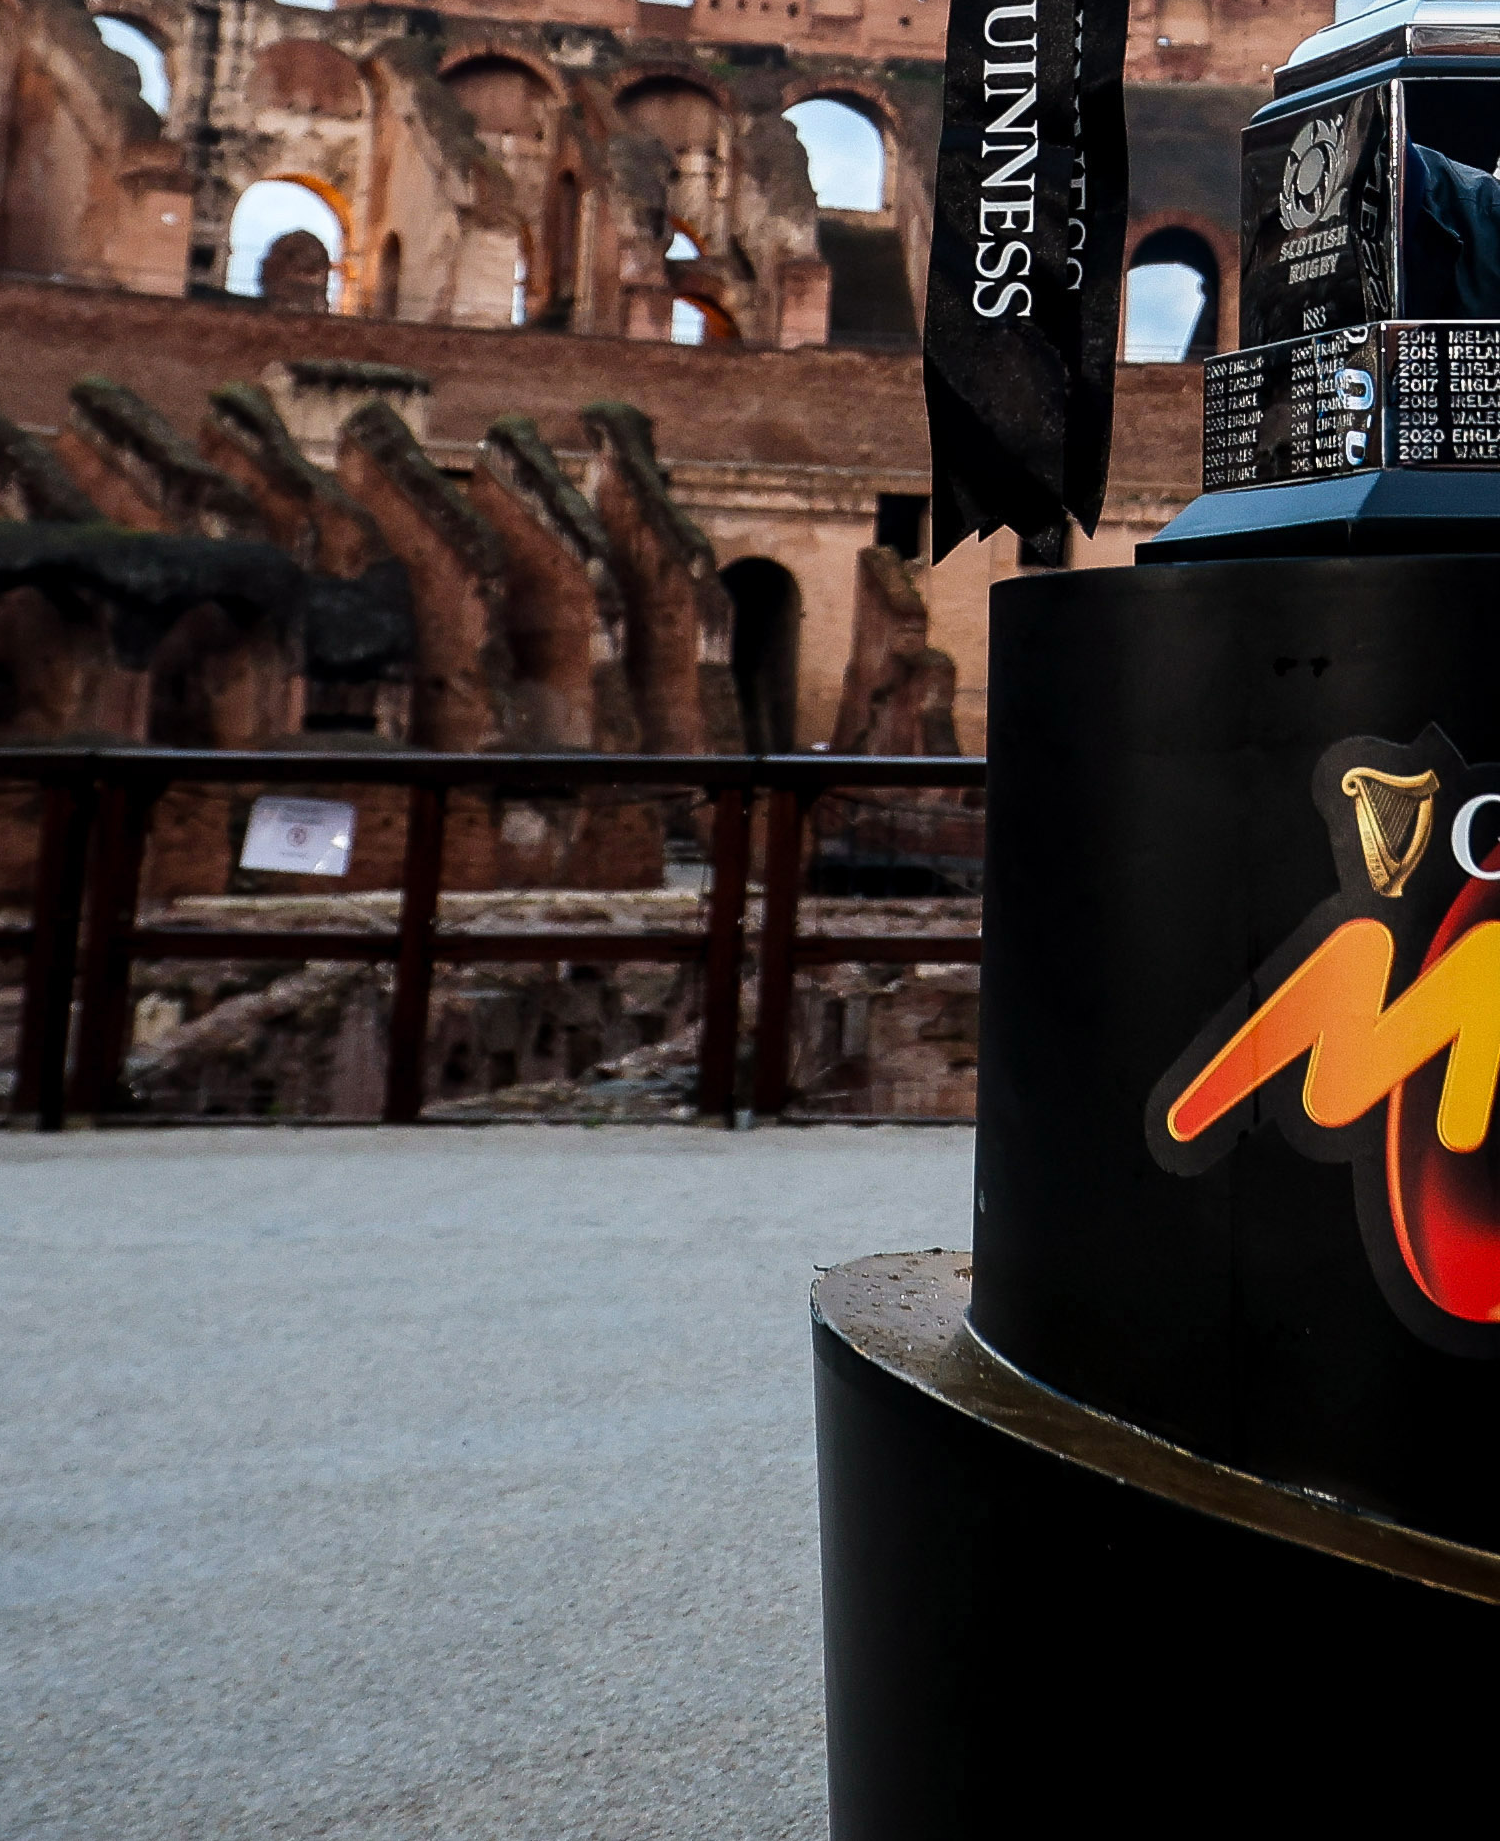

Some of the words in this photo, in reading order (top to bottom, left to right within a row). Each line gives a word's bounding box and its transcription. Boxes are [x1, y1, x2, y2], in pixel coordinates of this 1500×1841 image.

[1279, 224, 1349, 262] SCOTTISH
[1288, 252, 1340, 285] RUGBY
[1398, 330, 1436, 344] 2014
[1398, 346, 1438, 360] 2015
[1399, 378, 1439, 393] 2017
[1399, 395, 1438, 408] 2018
[1399, 411, 1438, 426] 2019
[1315, 433, 1344, 450] WALES
[1399, 429, 1446, 443] 2020
[1399, 445, 1438, 460] 2021
[1315, 452, 1344, 469] WALES
